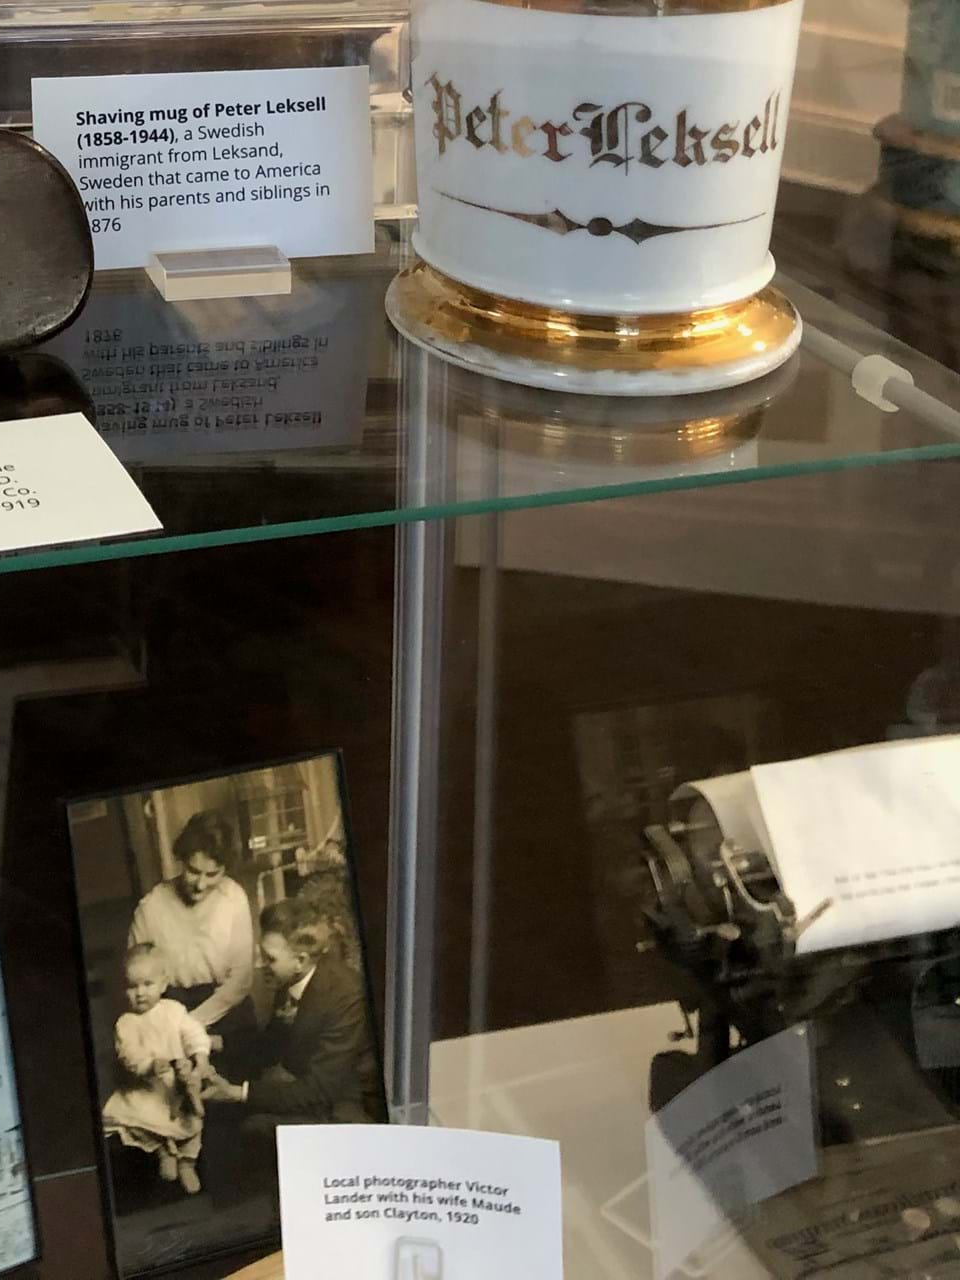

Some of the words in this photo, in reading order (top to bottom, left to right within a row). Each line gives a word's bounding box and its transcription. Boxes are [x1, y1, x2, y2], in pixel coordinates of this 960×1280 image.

[76, 109, 145, 128] Shaving
[149, 106, 188, 124] mug
[192, 103, 210, 119] of
[214, 101, 262, 117] Peter
[265, 96, 327, 114] Leksell
[424, 71, 574, 163] Peter
[573, 85, 784, 177] Leksell
[77, 127, 179, 150] (1858-1944),
[183, 128, 193, 141] a
[197, 121, 265, 140] Swedish
[78, 151, 164, 171] immigrant
[168, 148, 208, 164] from
[212, 142, 284, 161] Leksand,
[79, 172, 144, 191] Sweden
[148, 170, 181, 186] that
[186, 169, 230, 184] came
[234, 167, 251, 181] to
[255, 161, 322, 179] America
[84, 195, 115, 213] with
[120, 193, 144, 210] his
[148, 189, 211, 211] parents
[215, 187, 246, 203] and
[250, 182, 311, 201] siblings
[315, 182, 330, 197] in
[90, 217, 122, 234] 876
[2, 486, 38, 497] Co.
[323, 1175, 360, 1189] Local
[363, 1175, 461, 1191] photographer
[465, 1180, 509, 1198] Victor
[324, 1191, 373, 1205] Lander
[377, 1190, 409, 1204] with
[412, 1192, 434, 1206] his
[437, 1193, 468, 1208] wife
[471, 1197, 522, 1216] Maude
[325, 1209, 352, 1222] and
[355, 1209, 380, 1220] son
[383, 1206, 443, 1223] Clayton,
[446, 1210, 480, 1225] 1920
